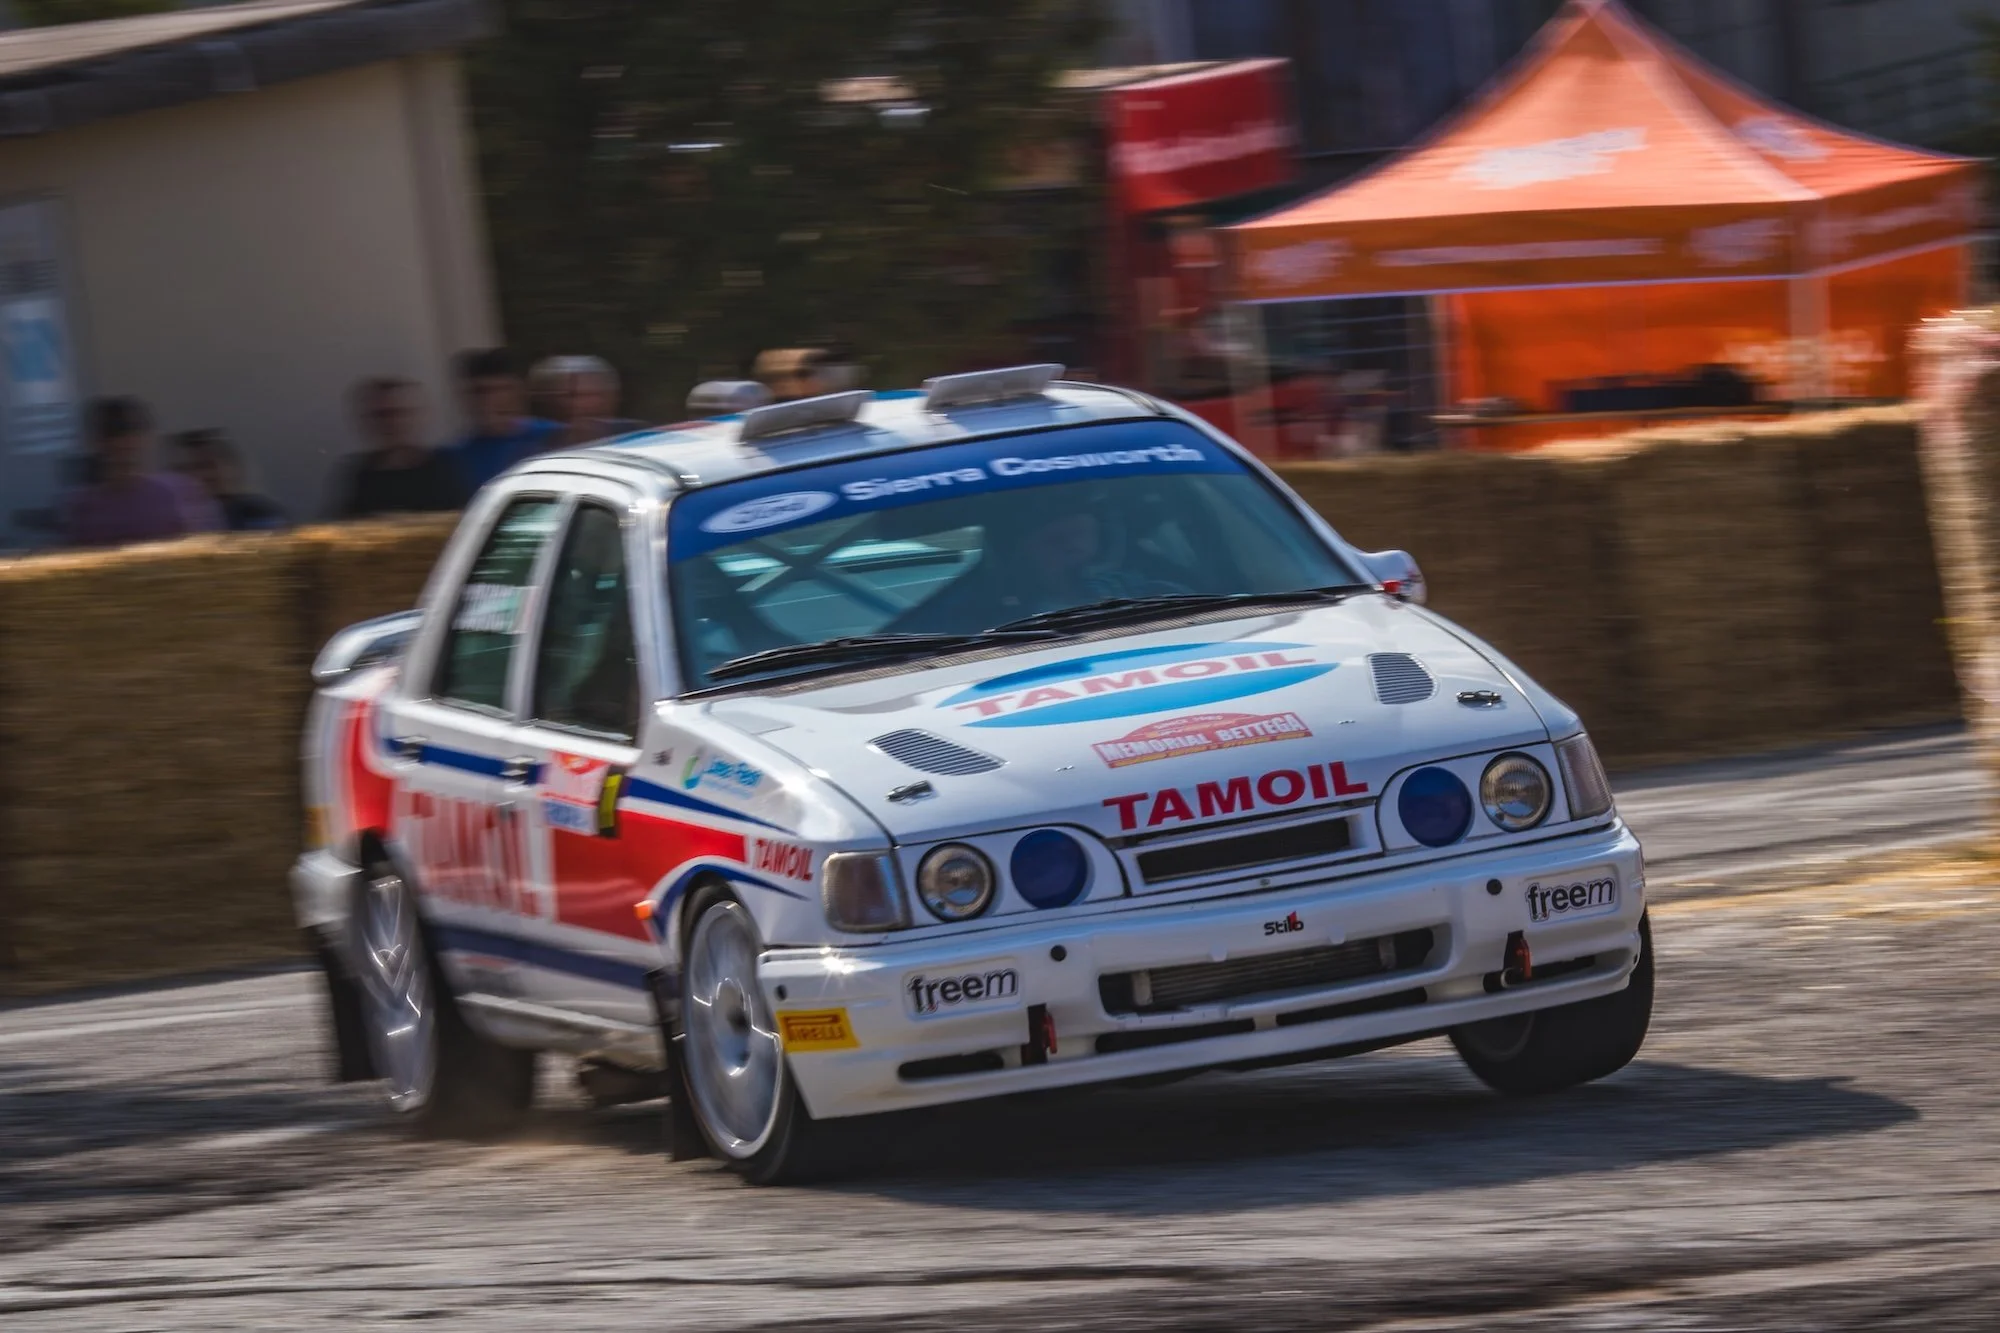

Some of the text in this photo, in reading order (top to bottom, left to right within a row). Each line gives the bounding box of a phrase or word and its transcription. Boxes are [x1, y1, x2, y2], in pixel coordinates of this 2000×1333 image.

[841, 444, 1205, 501] Sierra Cosworth
[953, 652, 1316, 716] TAMOIL
[1097, 733, 1212, 762] MEMORIAL
[1215, 714, 1305, 742] BETTEGA
[1103, 761, 1369, 831] TAMOIL
[753, 838, 814, 882] TAMOIL
[1527, 879, 1613, 921] freem
[908, 969, 1017, 1013] freem
